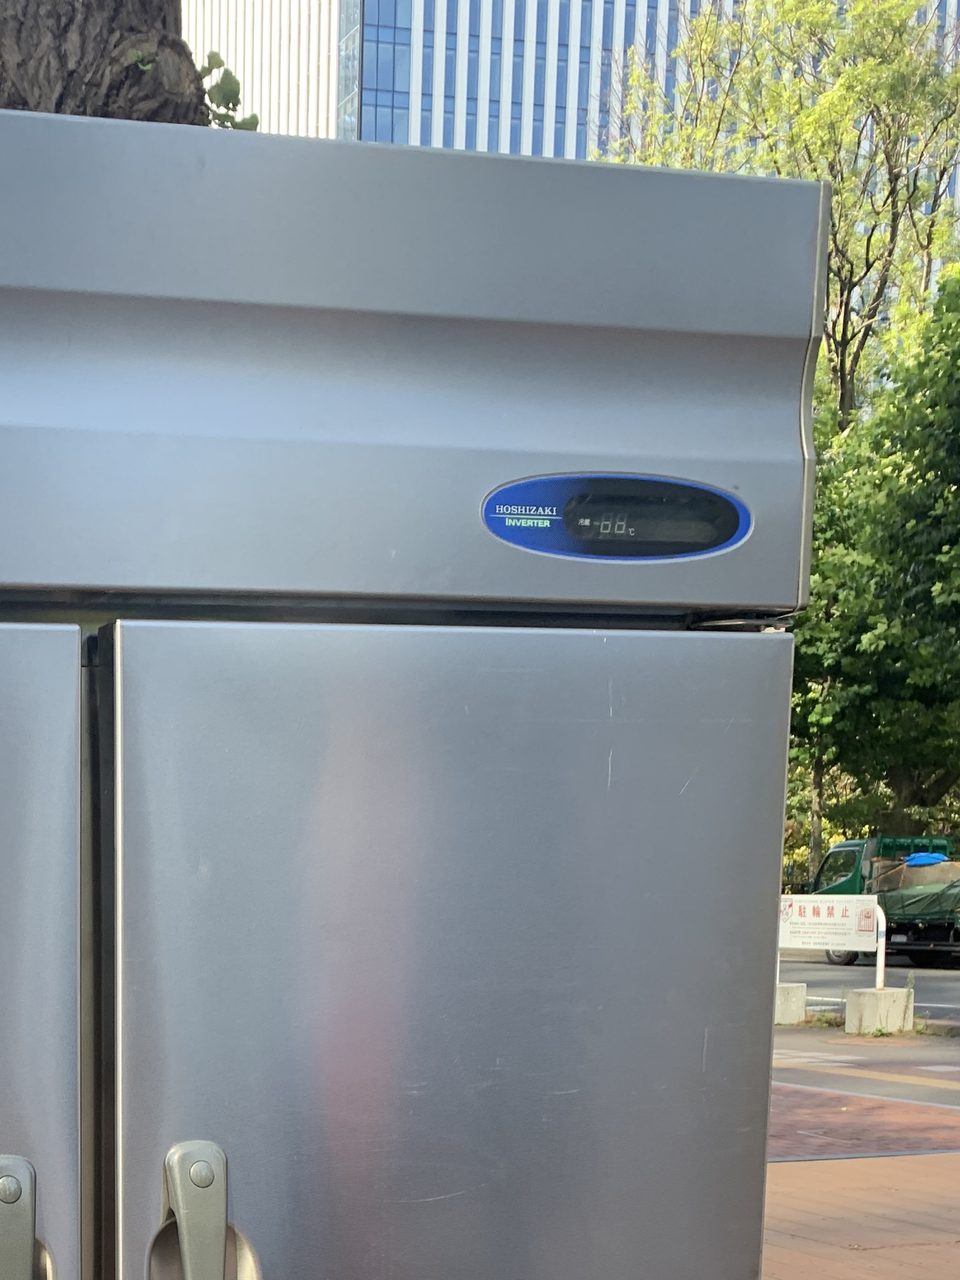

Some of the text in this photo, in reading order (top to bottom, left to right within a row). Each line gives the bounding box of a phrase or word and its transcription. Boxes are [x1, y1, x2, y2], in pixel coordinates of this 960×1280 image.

[495, 505, 557, 516] HOSHIZAKI
[505, 517, 551, 528] INVERTER
[798, 905, 850, 918] 駐輪禁止
